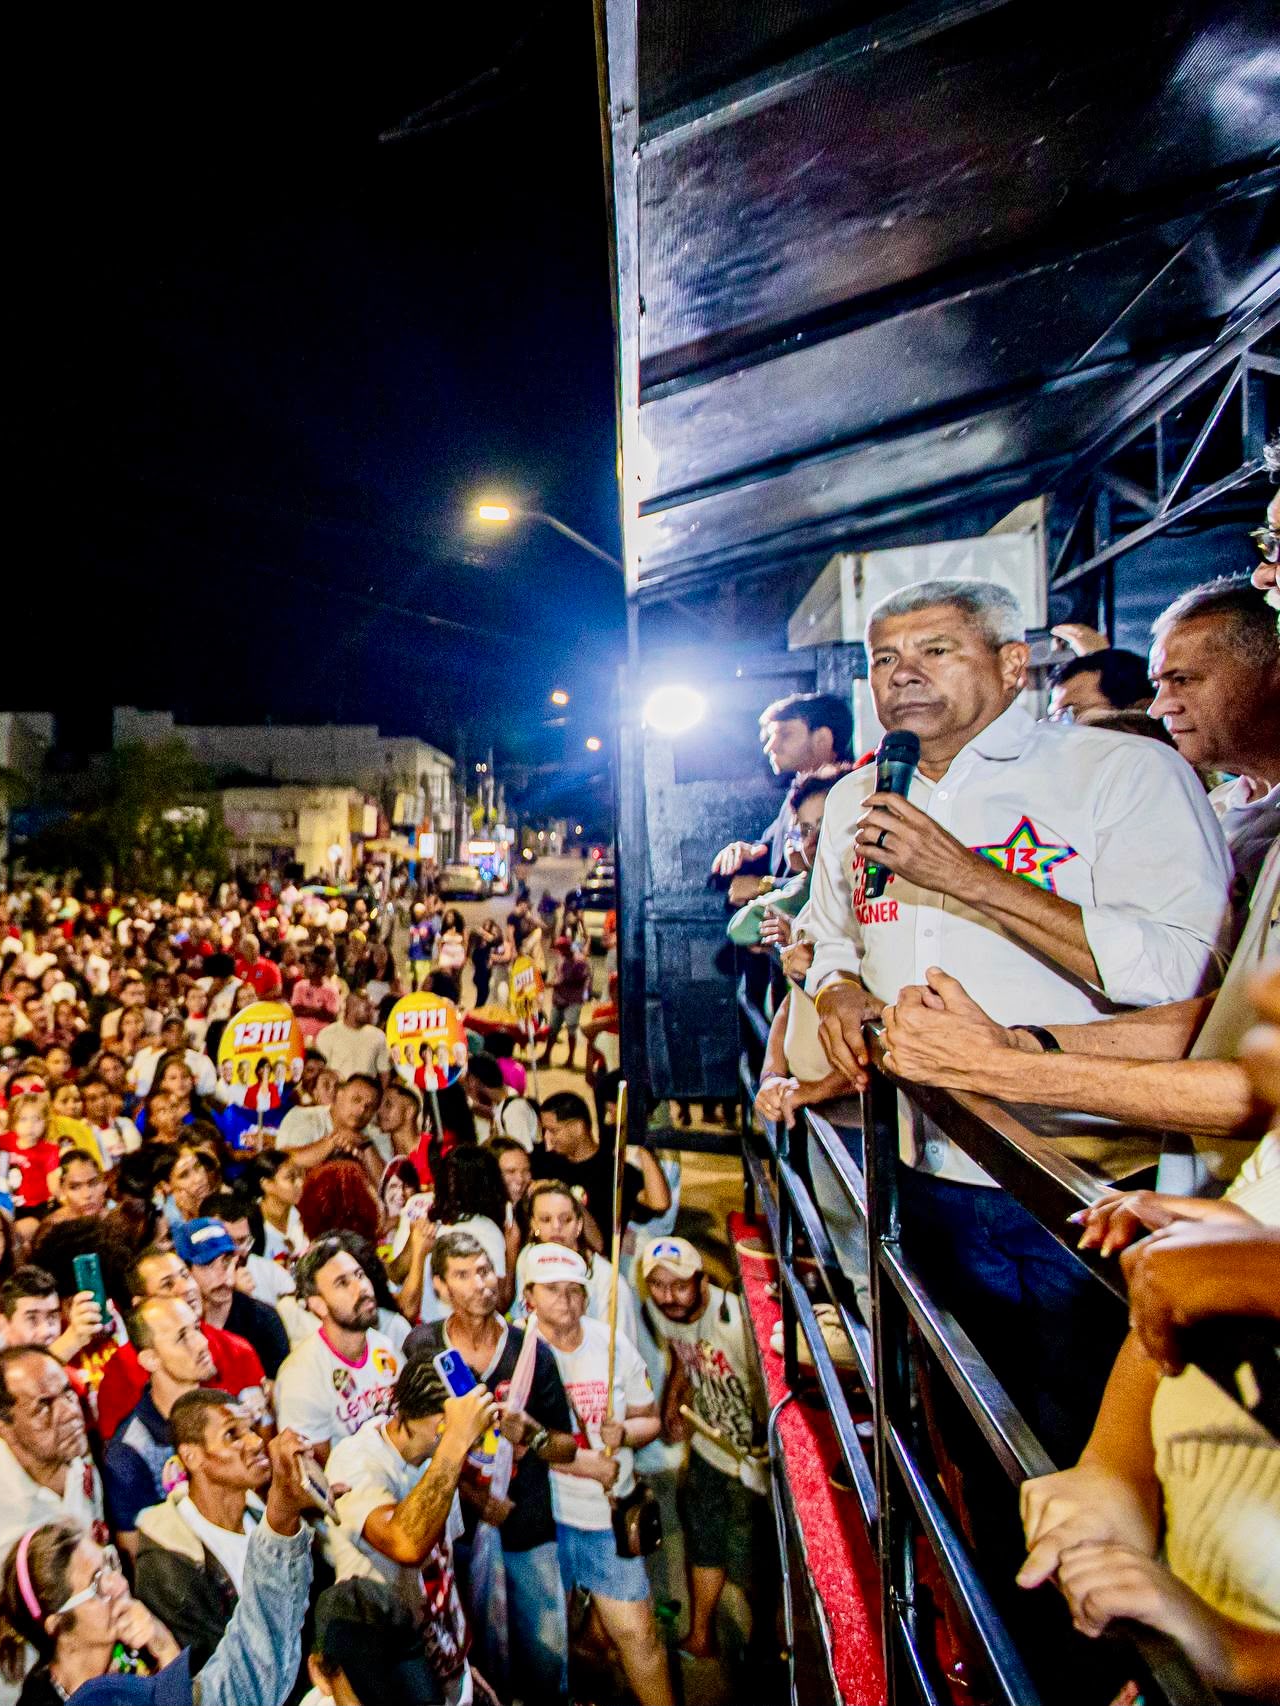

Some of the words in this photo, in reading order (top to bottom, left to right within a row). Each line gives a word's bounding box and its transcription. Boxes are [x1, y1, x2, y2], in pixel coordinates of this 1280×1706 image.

[1005, 847, 1038, 874] 13
[233, 1020, 293, 1047] 13111
[395, 1007, 448, 1033] 13111
